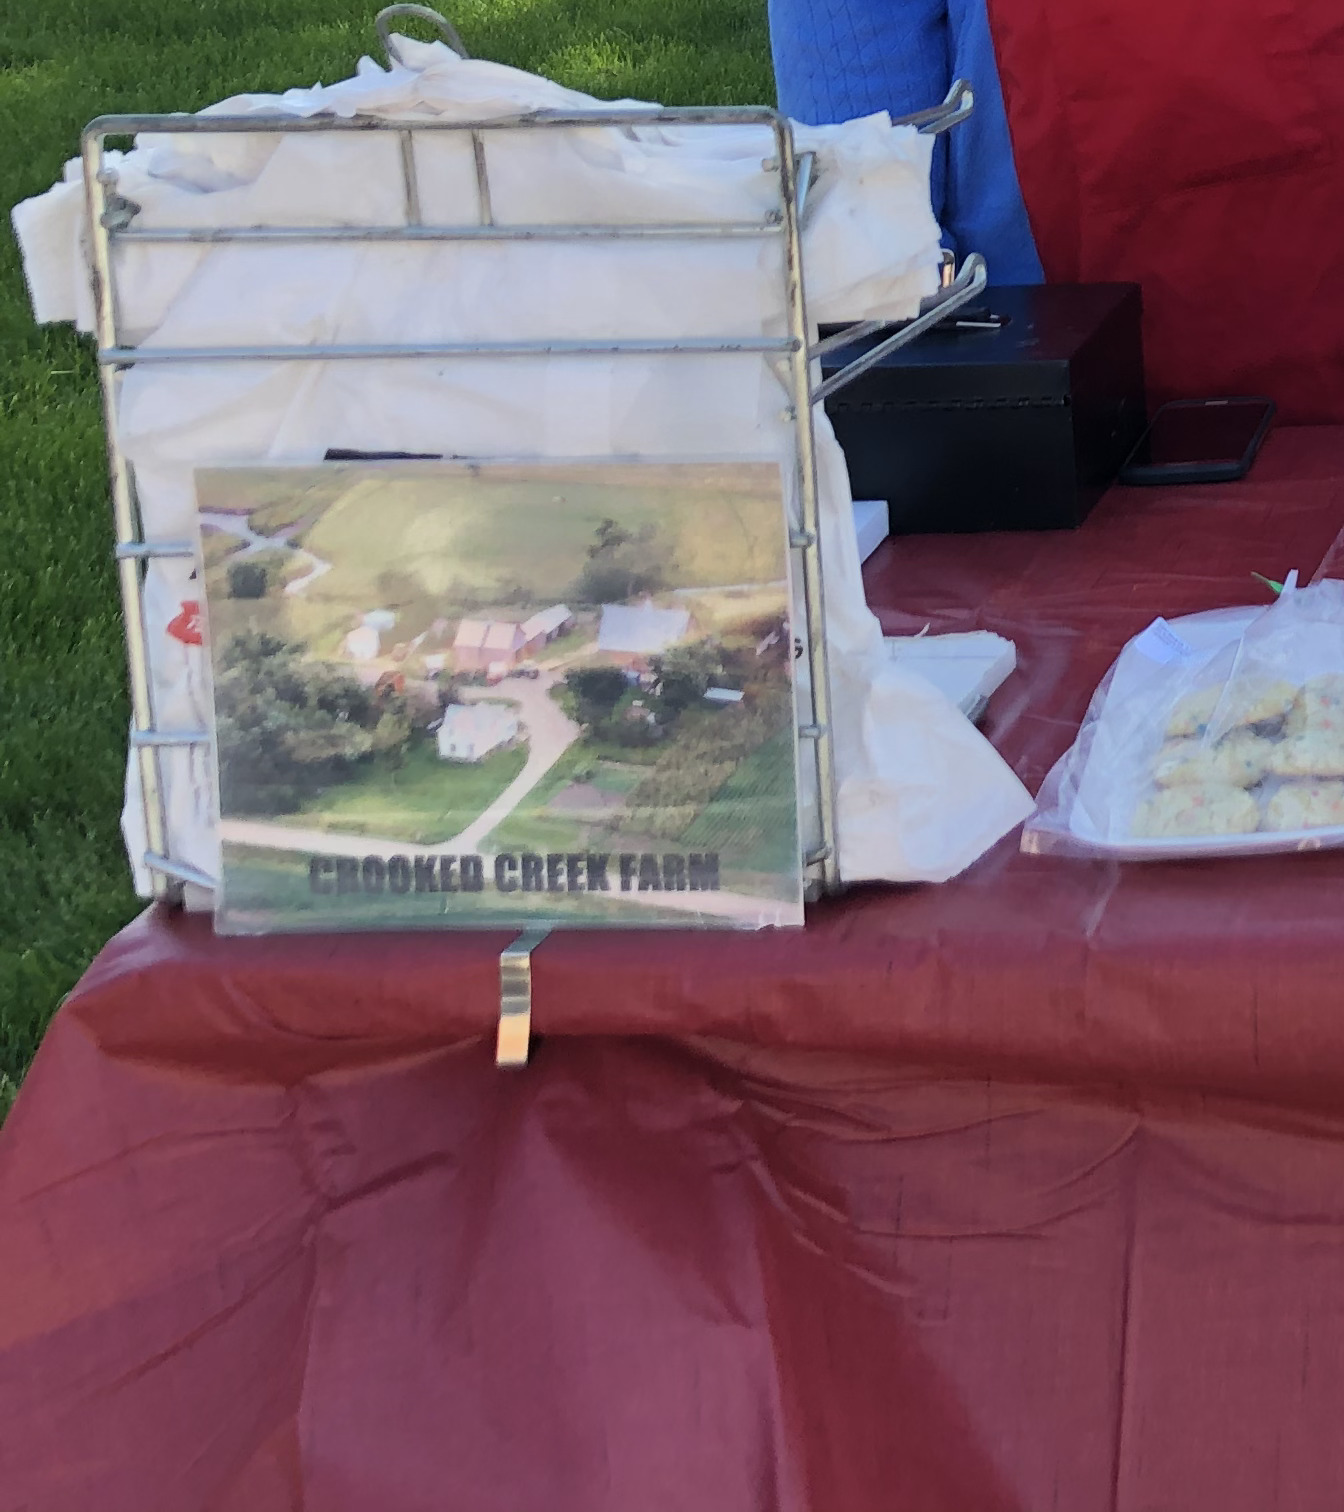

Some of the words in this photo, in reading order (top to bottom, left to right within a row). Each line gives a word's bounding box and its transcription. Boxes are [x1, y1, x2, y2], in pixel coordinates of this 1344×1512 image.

[309, 854, 485, 893] CROOKED
[495, 852, 611, 892] CREEK
[619, 852, 721, 892] FARM
